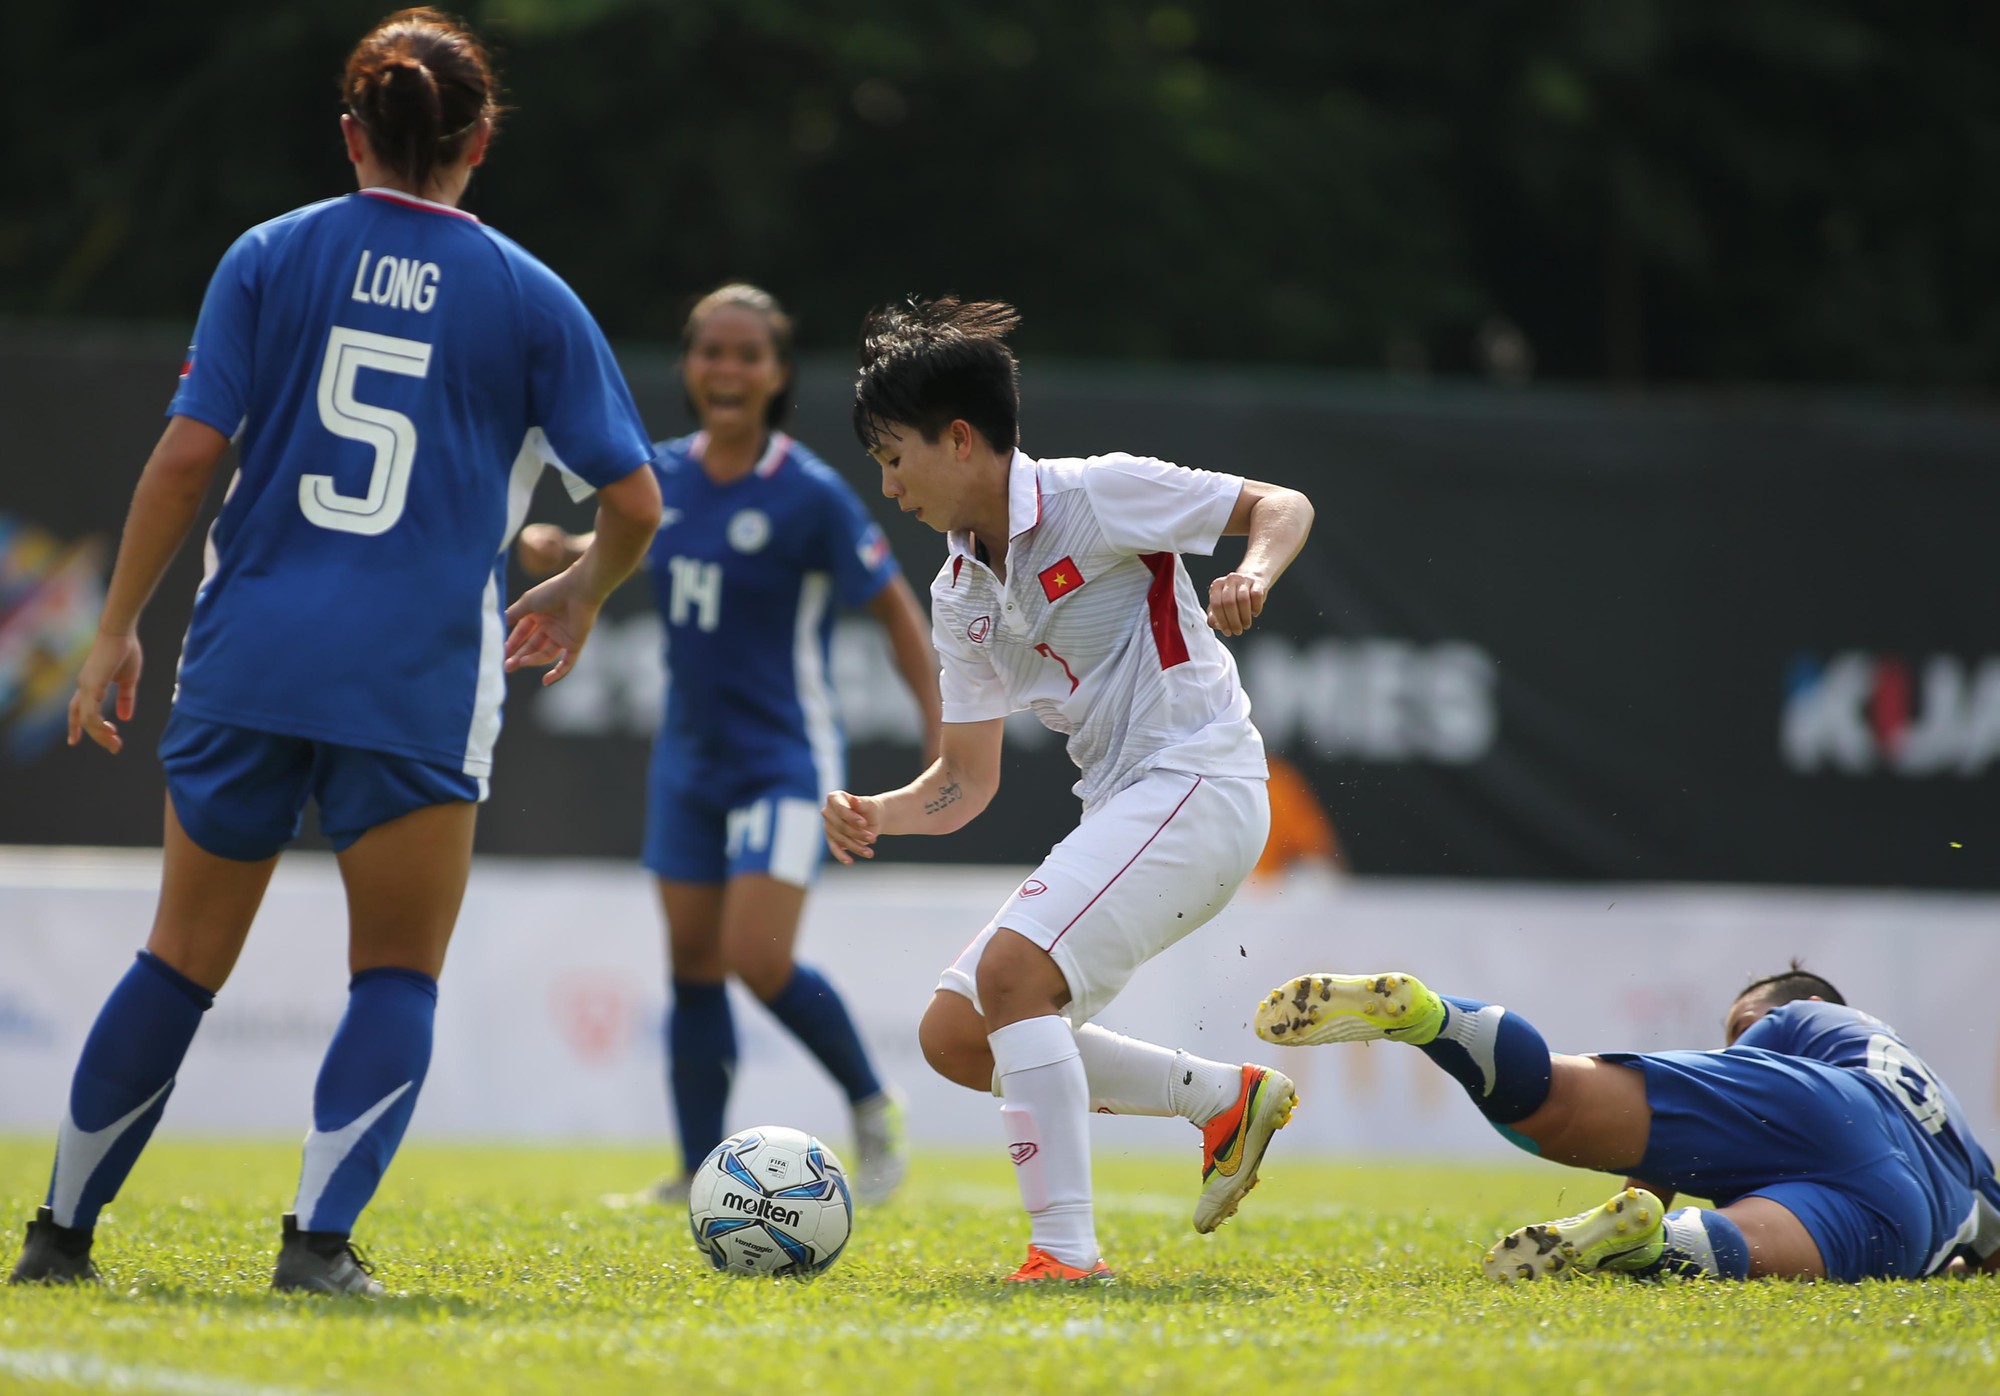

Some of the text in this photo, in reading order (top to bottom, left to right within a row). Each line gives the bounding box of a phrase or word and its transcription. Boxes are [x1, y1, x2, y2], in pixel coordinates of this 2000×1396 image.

[351, 249, 441, 314] LONG
[298, 326, 433, 536] 5
[668, 555, 723, 634] 14
[1034, 642, 1080, 696] 7
[1248, 636, 1497, 763] MES
[725, 796, 773, 858] 14
[770, 1158, 787, 1168] FIFA
[722, 1191, 801, 1228] molten
